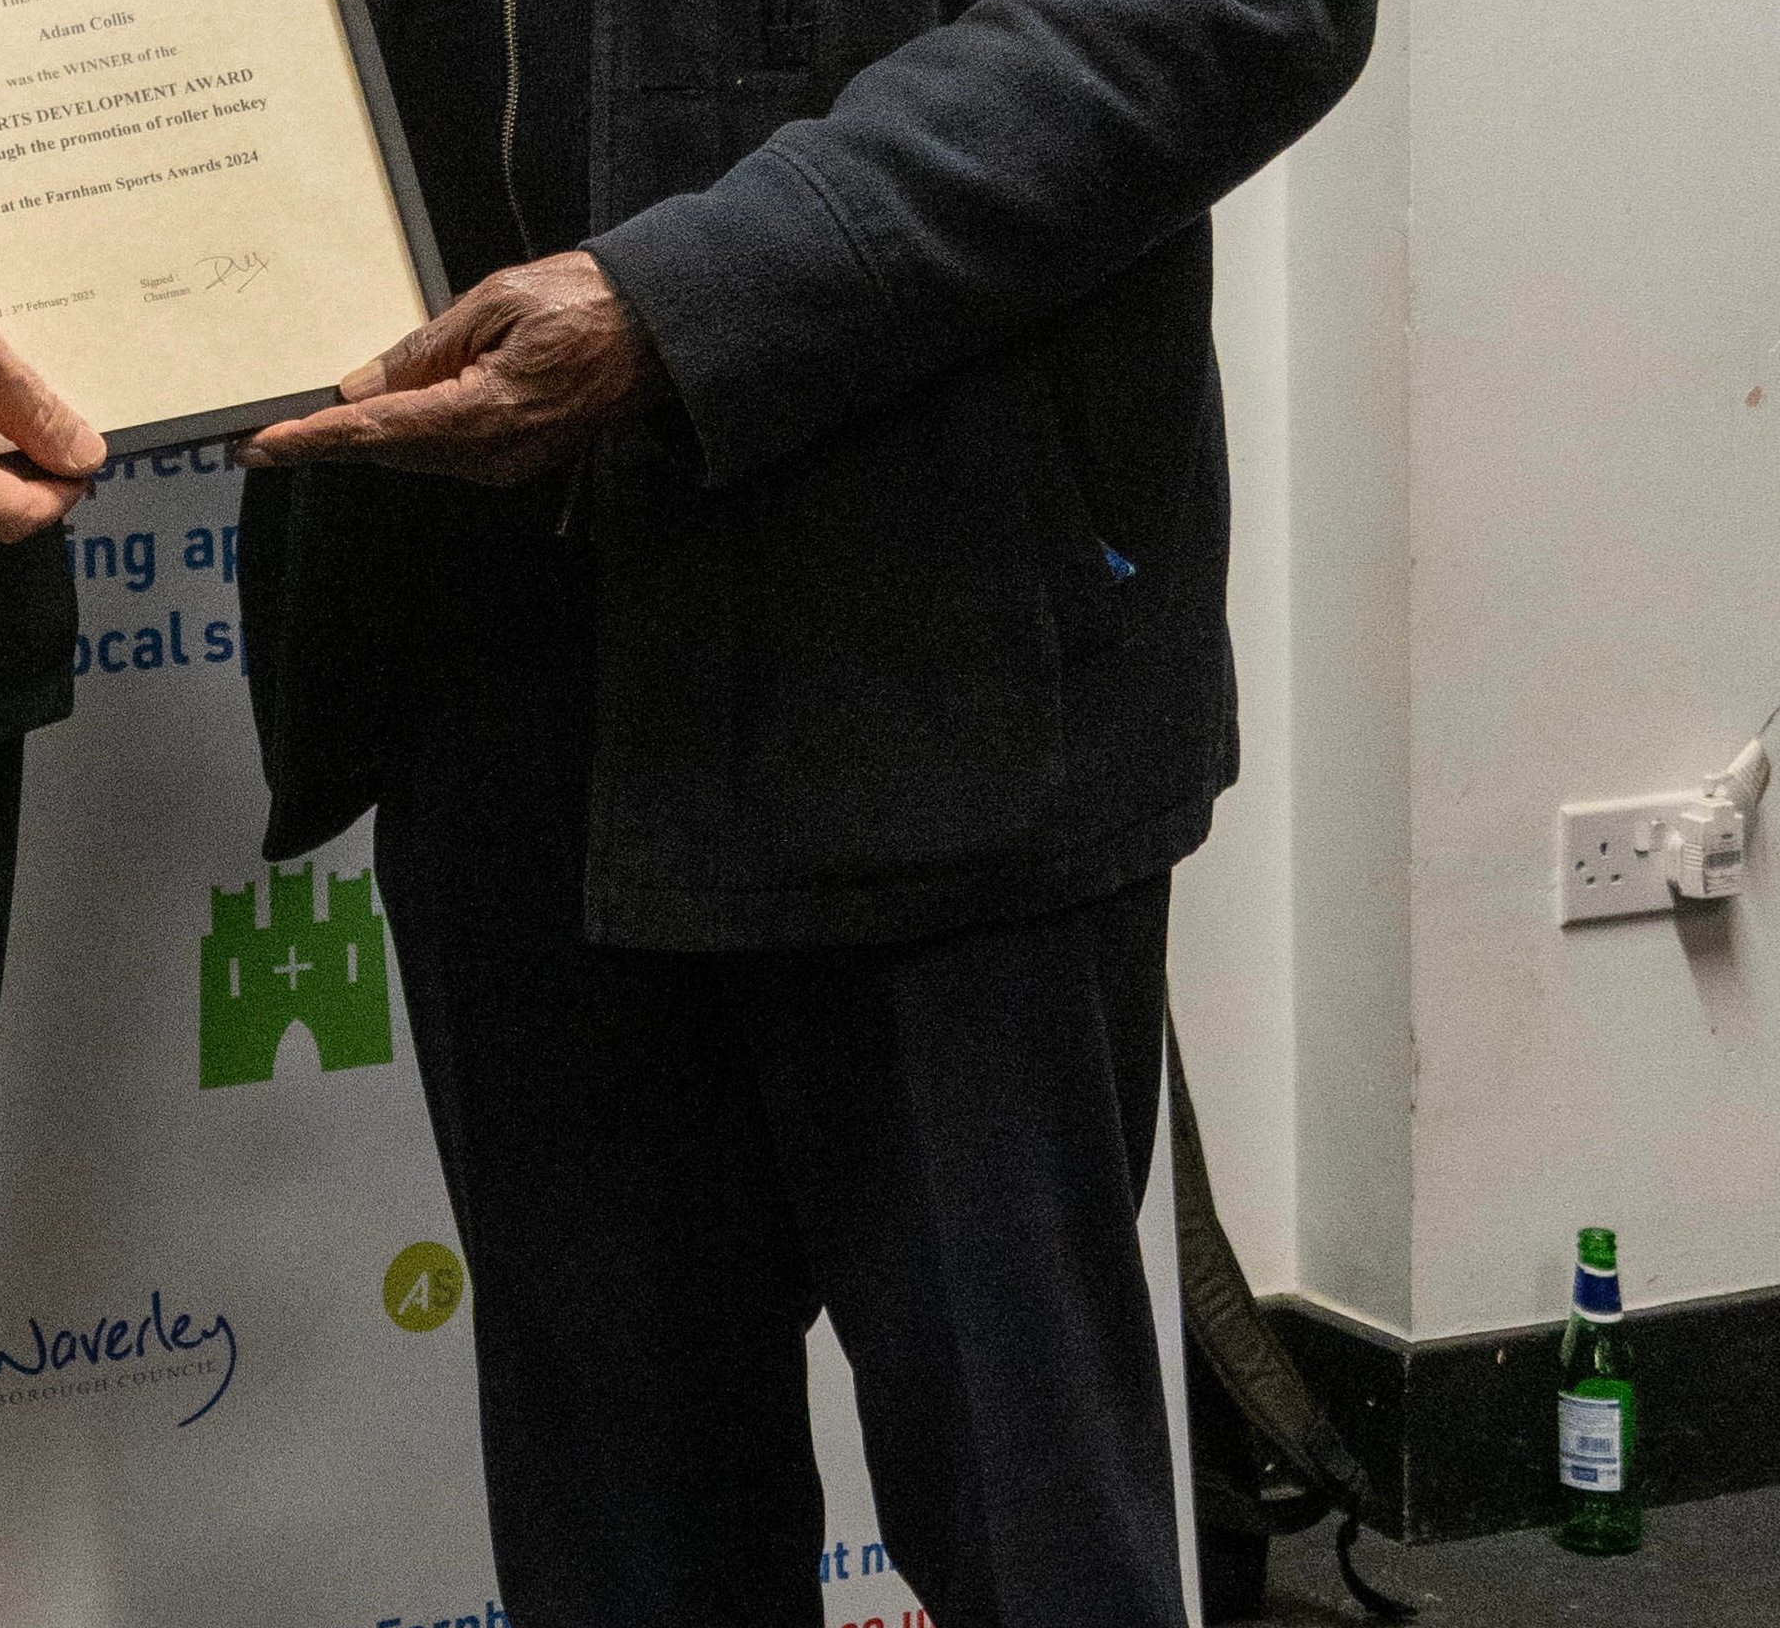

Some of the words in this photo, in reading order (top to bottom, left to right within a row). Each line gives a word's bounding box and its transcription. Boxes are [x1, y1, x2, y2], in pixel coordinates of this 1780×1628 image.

[38, 22, 86, 42] Adam
[90, 11, 135, 31] Collis
[6, 74, 35, 89] was
[37, 68, 61, 83] the
[63, 53, 134, 77] WINNER
[137, 48, 152, 62] of
[154, 44, 178, 59] the
[36, 83, 178, 123] DEVELOPMENT
[183, 68, 254, 95] AWARD
[30, 137, 56, 154] the
[59, 123, 142, 152] promotion
[145, 115, 162, 132] of
[165, 107, 209, 128] roller
[213, 97, 268, 118] hockey
[0, 199, 15, 214] at
[17, 194, 43, 210] the
[45, 179, 112, 204] Farnham
[115, 172, 163, 192] Sports
[166, 159, 222, 181] Awards
[224, 150, 259, 169] 2024
[26, 296, 70, 314] February
[72, 289, 96, 304] 2025
[143, 286, 191, 304] Chairman
[116, 1360, 218, 1390] COUNCIL
